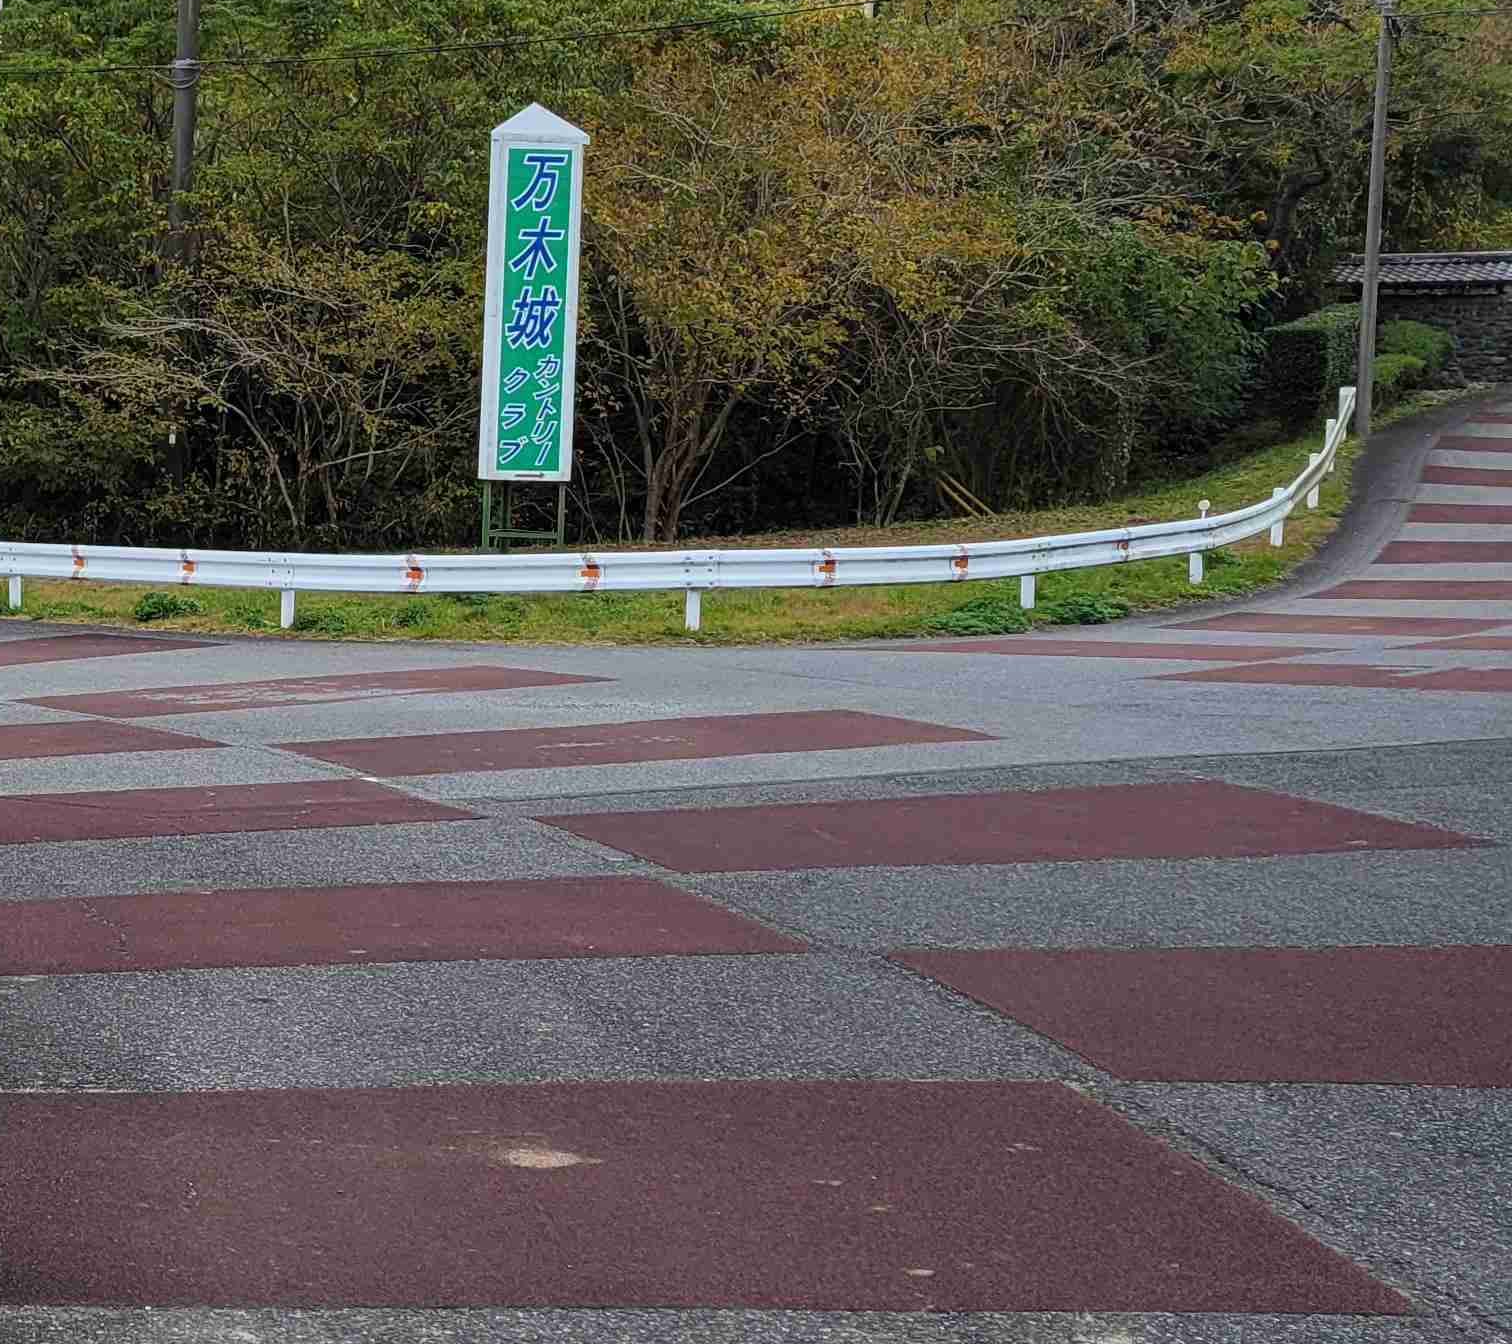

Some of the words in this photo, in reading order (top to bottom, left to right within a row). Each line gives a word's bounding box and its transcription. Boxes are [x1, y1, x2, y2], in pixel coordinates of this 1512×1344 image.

[505, 153, 569, 350] 万木城
[499, 367, 530, 464] クラブ
[531, 354, 561, 466] カントリー
